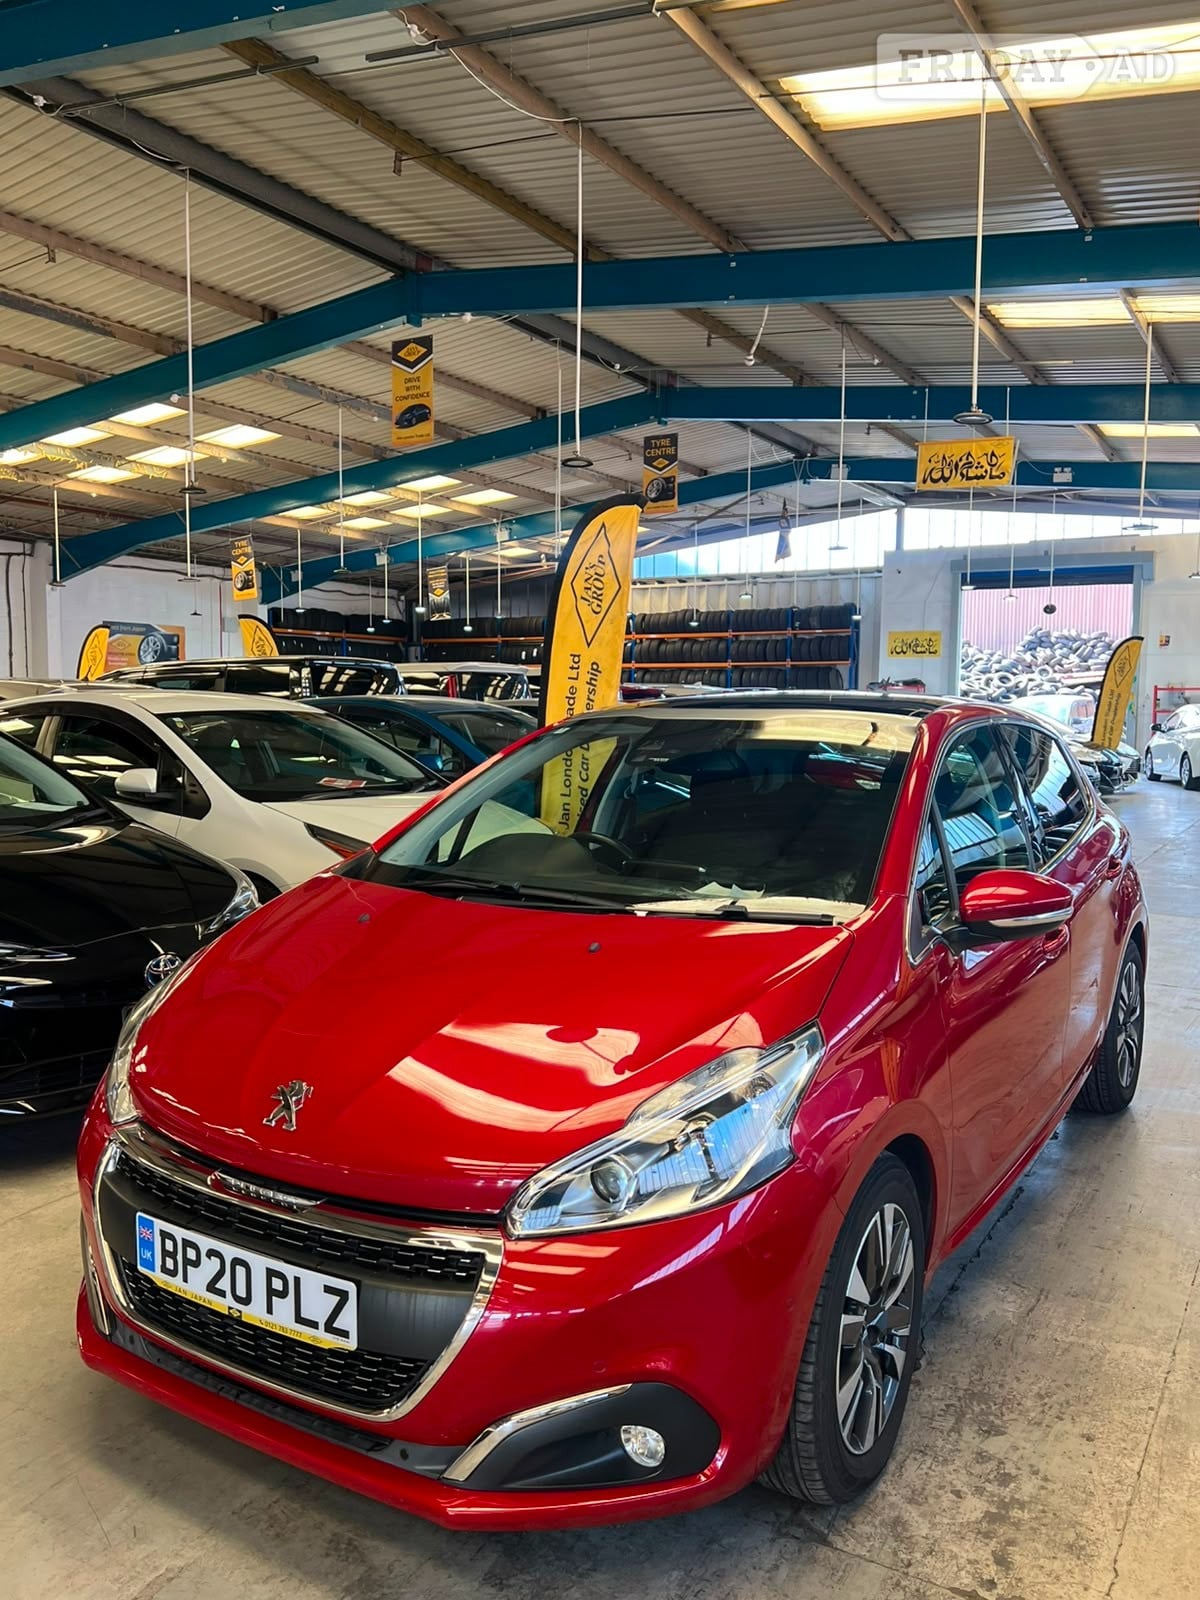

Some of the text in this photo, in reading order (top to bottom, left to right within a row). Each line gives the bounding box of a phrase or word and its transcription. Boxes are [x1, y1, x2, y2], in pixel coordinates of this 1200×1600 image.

[403, 375, 421, 385] DRIVE
[405, 384, 421, 392] WITH
[395, 391, 431, 402] CONFIDENCE
[645, 446, 677, 457] CENTRE
[651, 438, 672, 448] TYRE
[580, 562, 597, 607] JAN'S
[590, 554, 606, 615] GROUP
[558, 653, 581, 830] Jan Londo ade Ltd
[579, 753, 590, 783] Car
[140, 1248, 153, 1262] UK
[159, 1229, 350, 1340] BP20 PLZ
[174, 1284, 189, 1296] JAN
[190, 1288, 213, 1307] JAPAN
